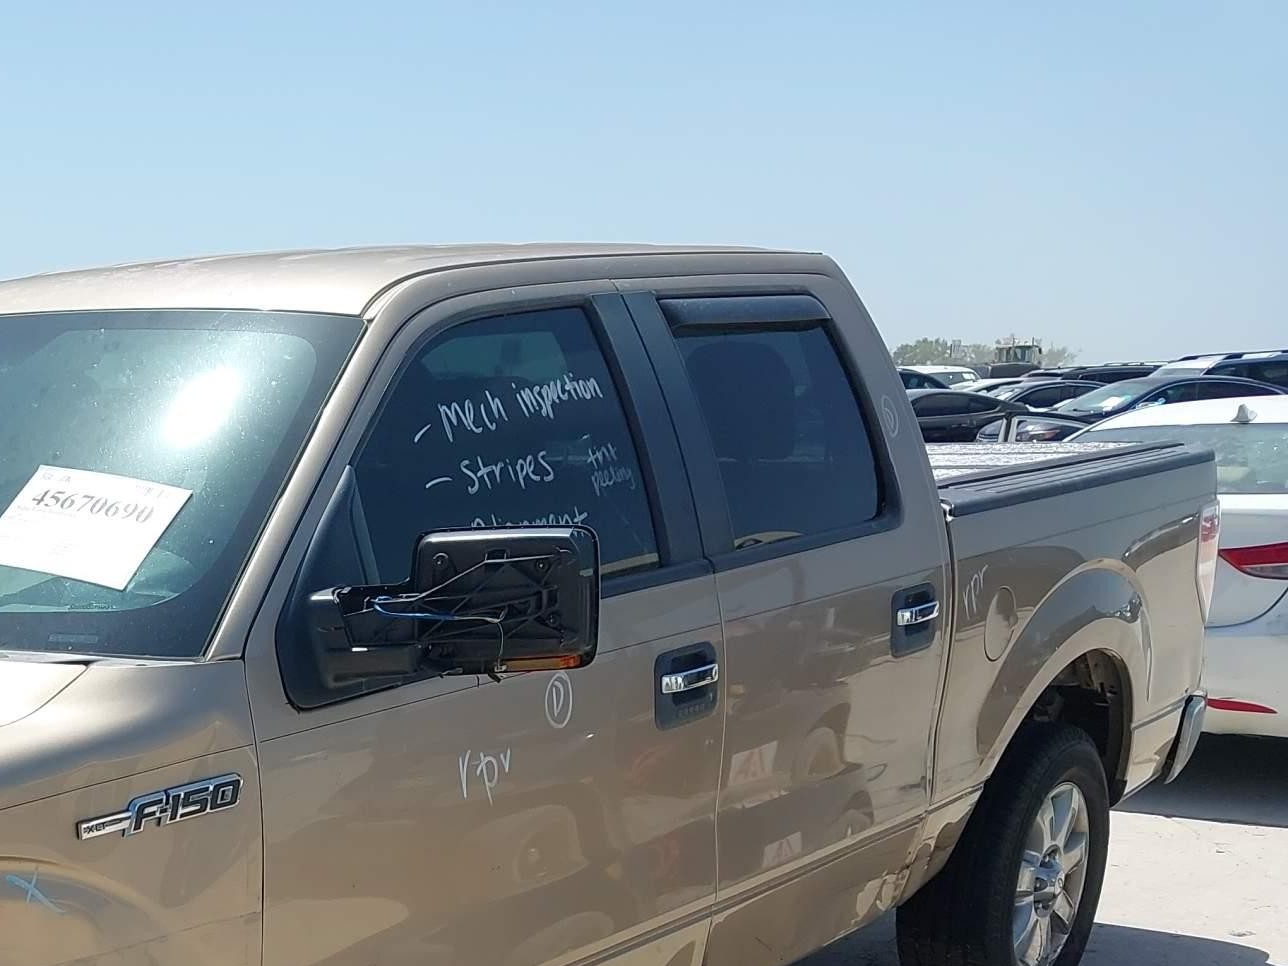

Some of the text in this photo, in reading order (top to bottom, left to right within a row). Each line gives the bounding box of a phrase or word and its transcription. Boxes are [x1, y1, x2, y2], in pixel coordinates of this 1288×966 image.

[438, 390, 509, 442] Mech
[512, 372, 603, 419] inspection
[31, 488, 155, 524] 45670690
[131, 776, 243, 833] F-150
